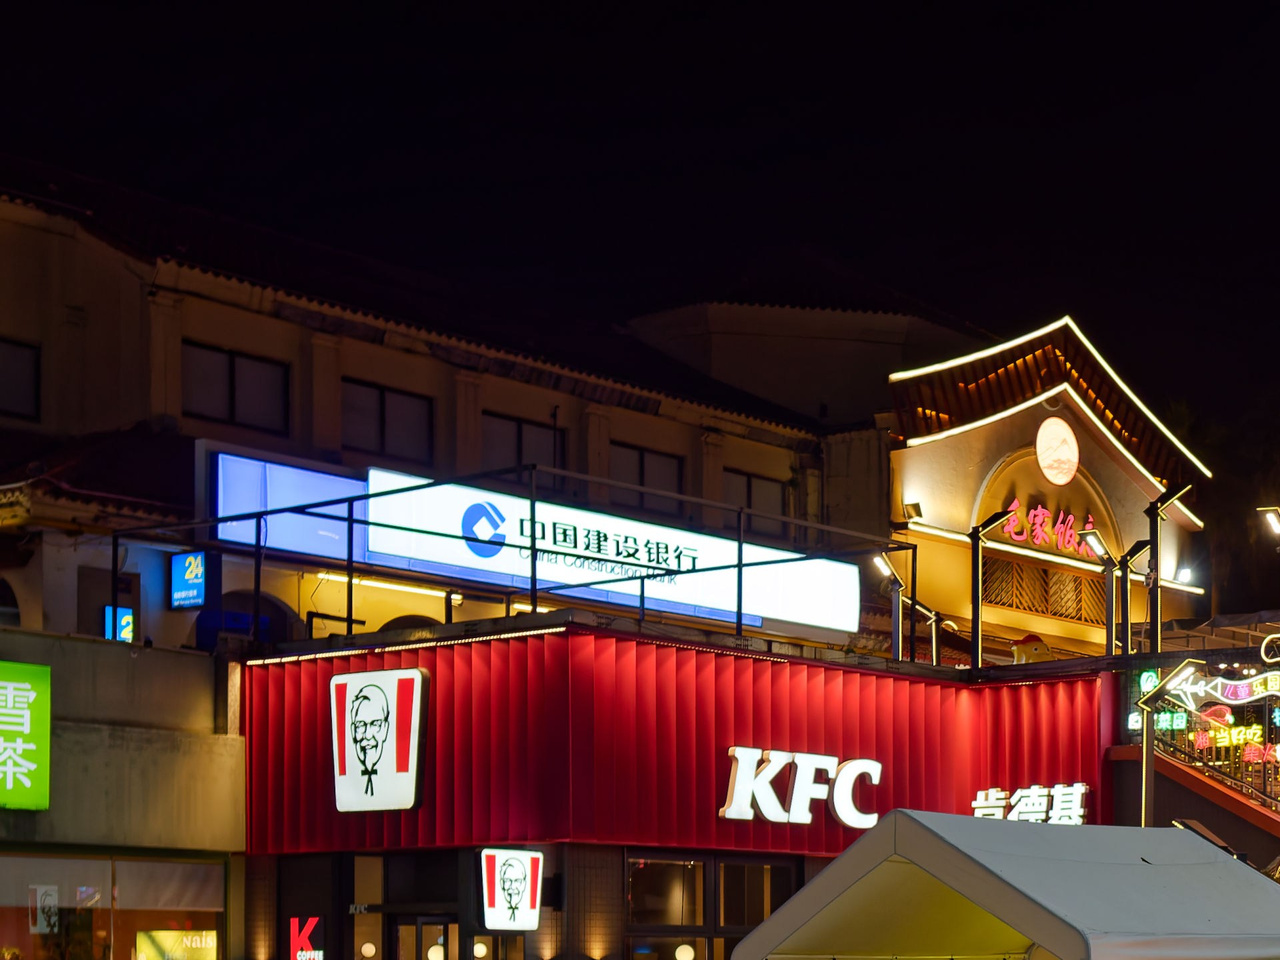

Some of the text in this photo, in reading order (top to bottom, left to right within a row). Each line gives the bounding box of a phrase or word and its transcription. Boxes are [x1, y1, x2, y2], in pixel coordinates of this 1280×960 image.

[519, 517, 699, 572] 中国建设银行
[185, 554, 203, 580] 24
[1224, 674, 1280, 699] 儿童乐园
[719, 746, 883, 829] KFC
[971, 782, 1091, 825] 肯德基
[296, 949, 324, 960] COFFEE
